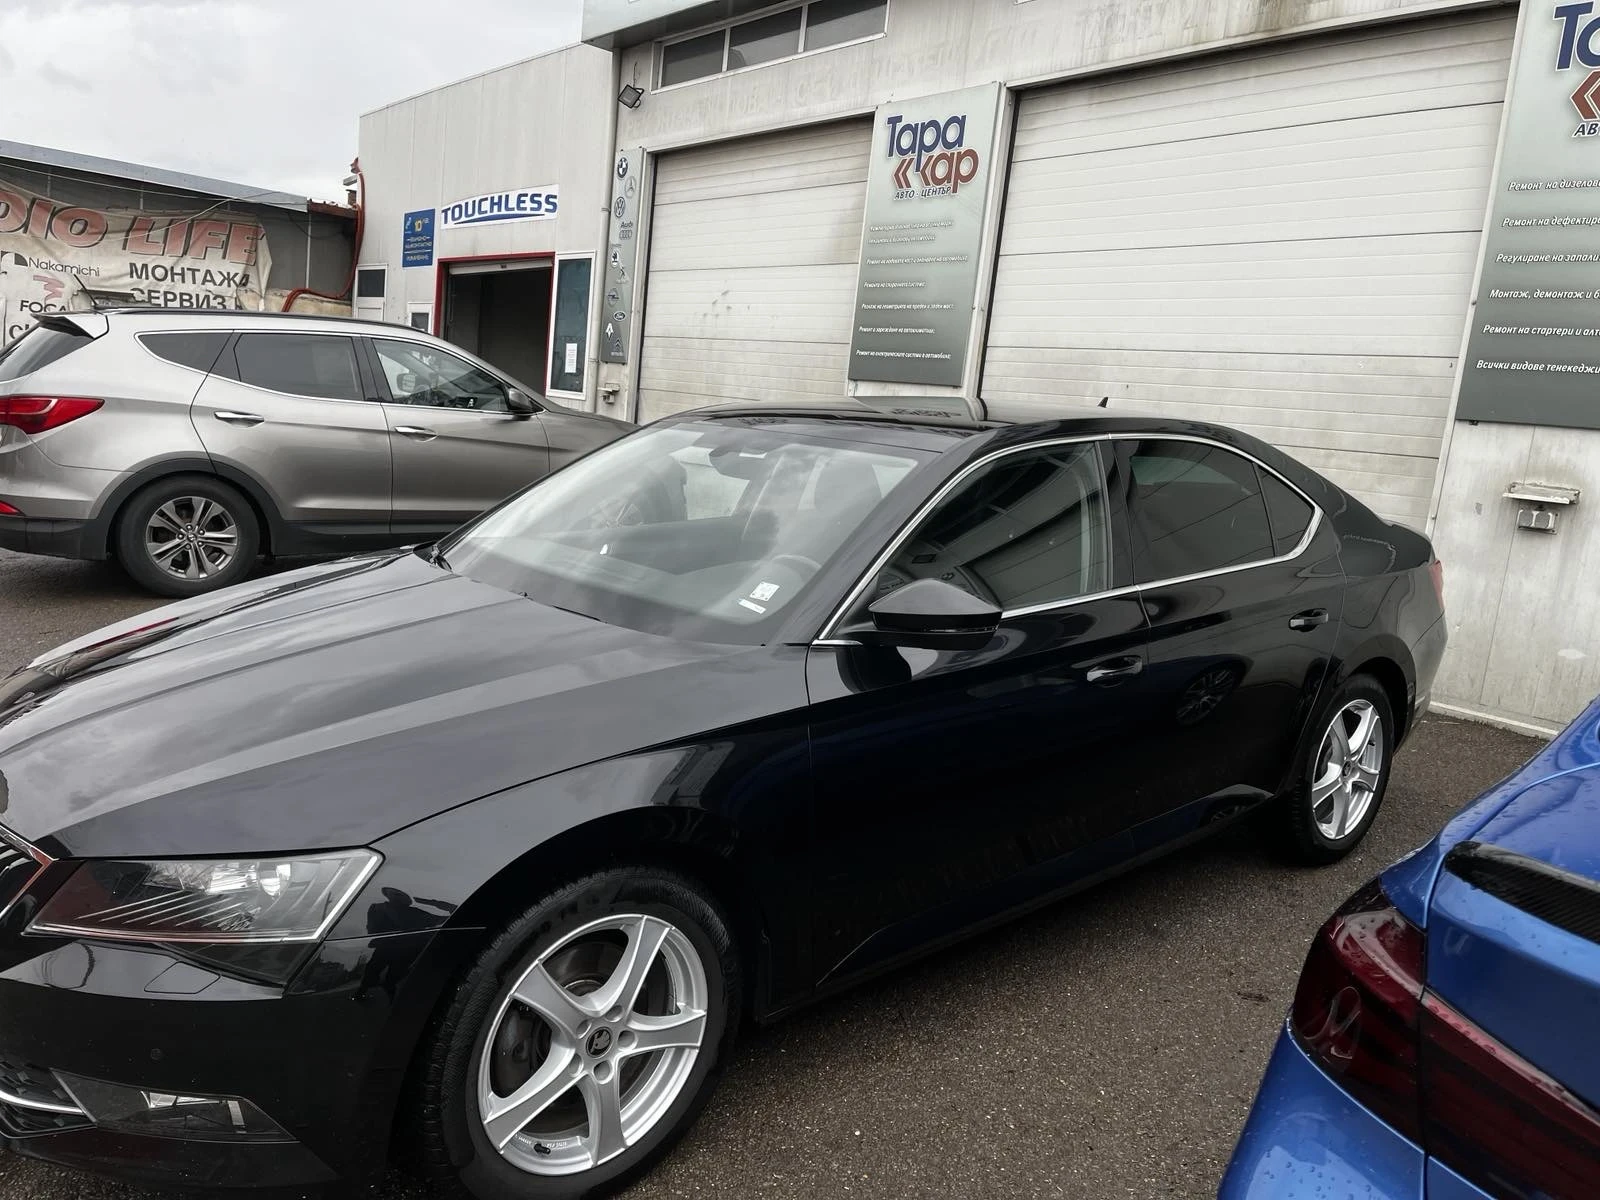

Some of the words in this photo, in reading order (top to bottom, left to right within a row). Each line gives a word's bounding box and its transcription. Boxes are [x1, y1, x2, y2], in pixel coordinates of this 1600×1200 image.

[887, 114, 967, 173] Тара
[1508, 181, 1543, 191] Ремонт
[1559, 178, 1600, 188] дизелов
[895, 190, 915, 199] АВТО
[441, 192, 558, 225] TOUCHLESS
[1502, 217, 1537, 227] Ремонт
[1537, 218, 1549, 226] на
[122, 215, 266, 266] LIFE
[1495, 254, 1550, 263] Регулиране
[1551, 254, 1563, 262] на
[1564, 254, 1600, 262] запали
[28, 257, 100, 277] Nakamichi
[1489, 289, 1531, 299] Монтаж,
[1533, 289, 1584, 299] демонтаж
[1483, 325, 1517, 334] Ремонт
[1531, 328, 1574, 337] стартери
[1575, 328, 1582, 336] и
[1476, 360, 1509, 369] Всички
[1511, 361, 1545, 371] видове
